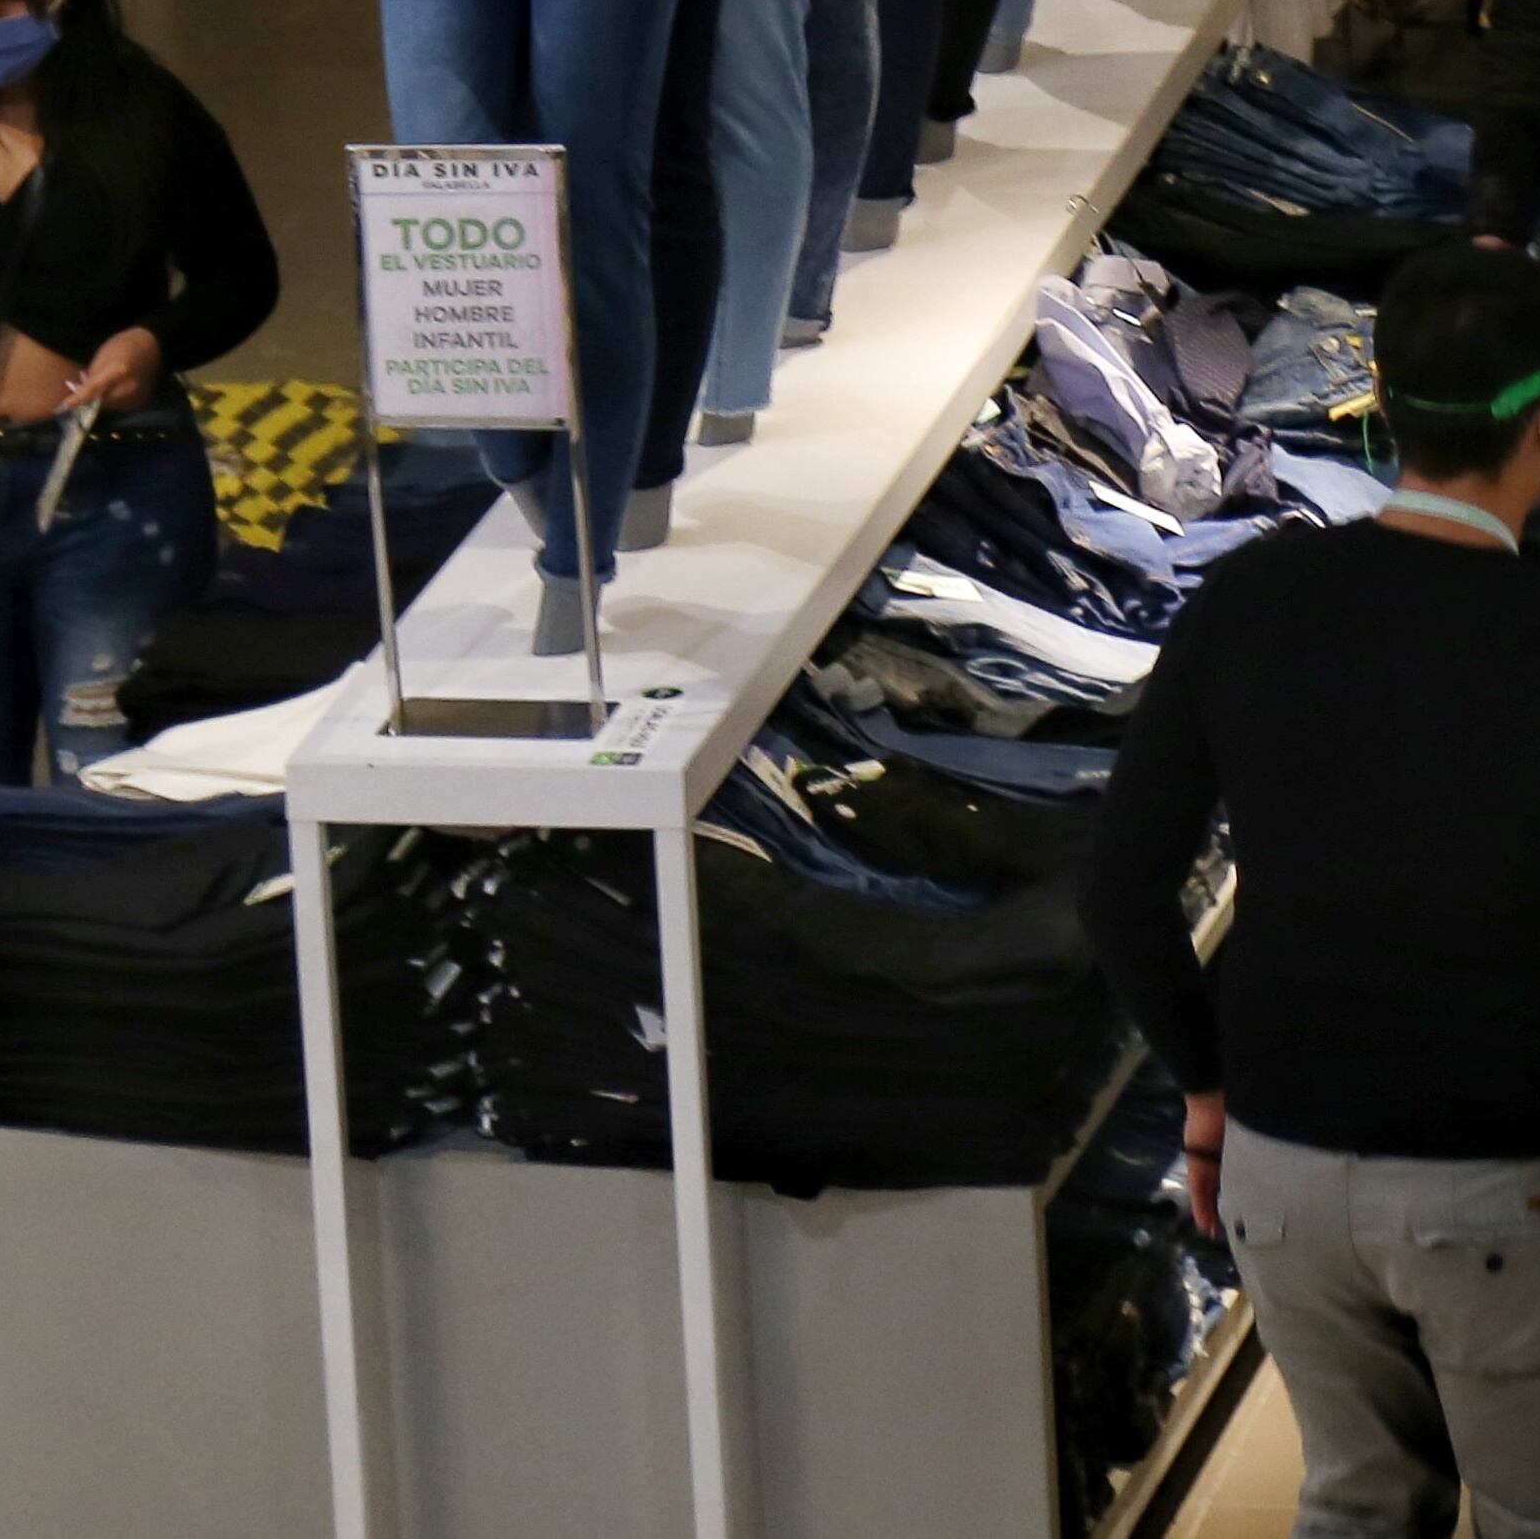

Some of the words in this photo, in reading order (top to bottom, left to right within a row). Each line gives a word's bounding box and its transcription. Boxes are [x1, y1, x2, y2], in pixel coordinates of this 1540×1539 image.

[432, 162, 479, 178] SIN
[492, 162, 539, 178] IVA
[391, 217, 526, 251] TODO
[380, 254, 408, 271] EL
[412, 253, 543, 271] VESTUARIO
[422, 279, 503, 297] MUJER
[414, 305, 515, 323] HOMBRE
[413, 331, 520, 349] INFANTIL
[385, 358, 503, 376] PARTICIPA
[507, 359, 549, 375] DEL
[452, 377, 489, 395] SIN
[493, 377, 531, 395] IVA
